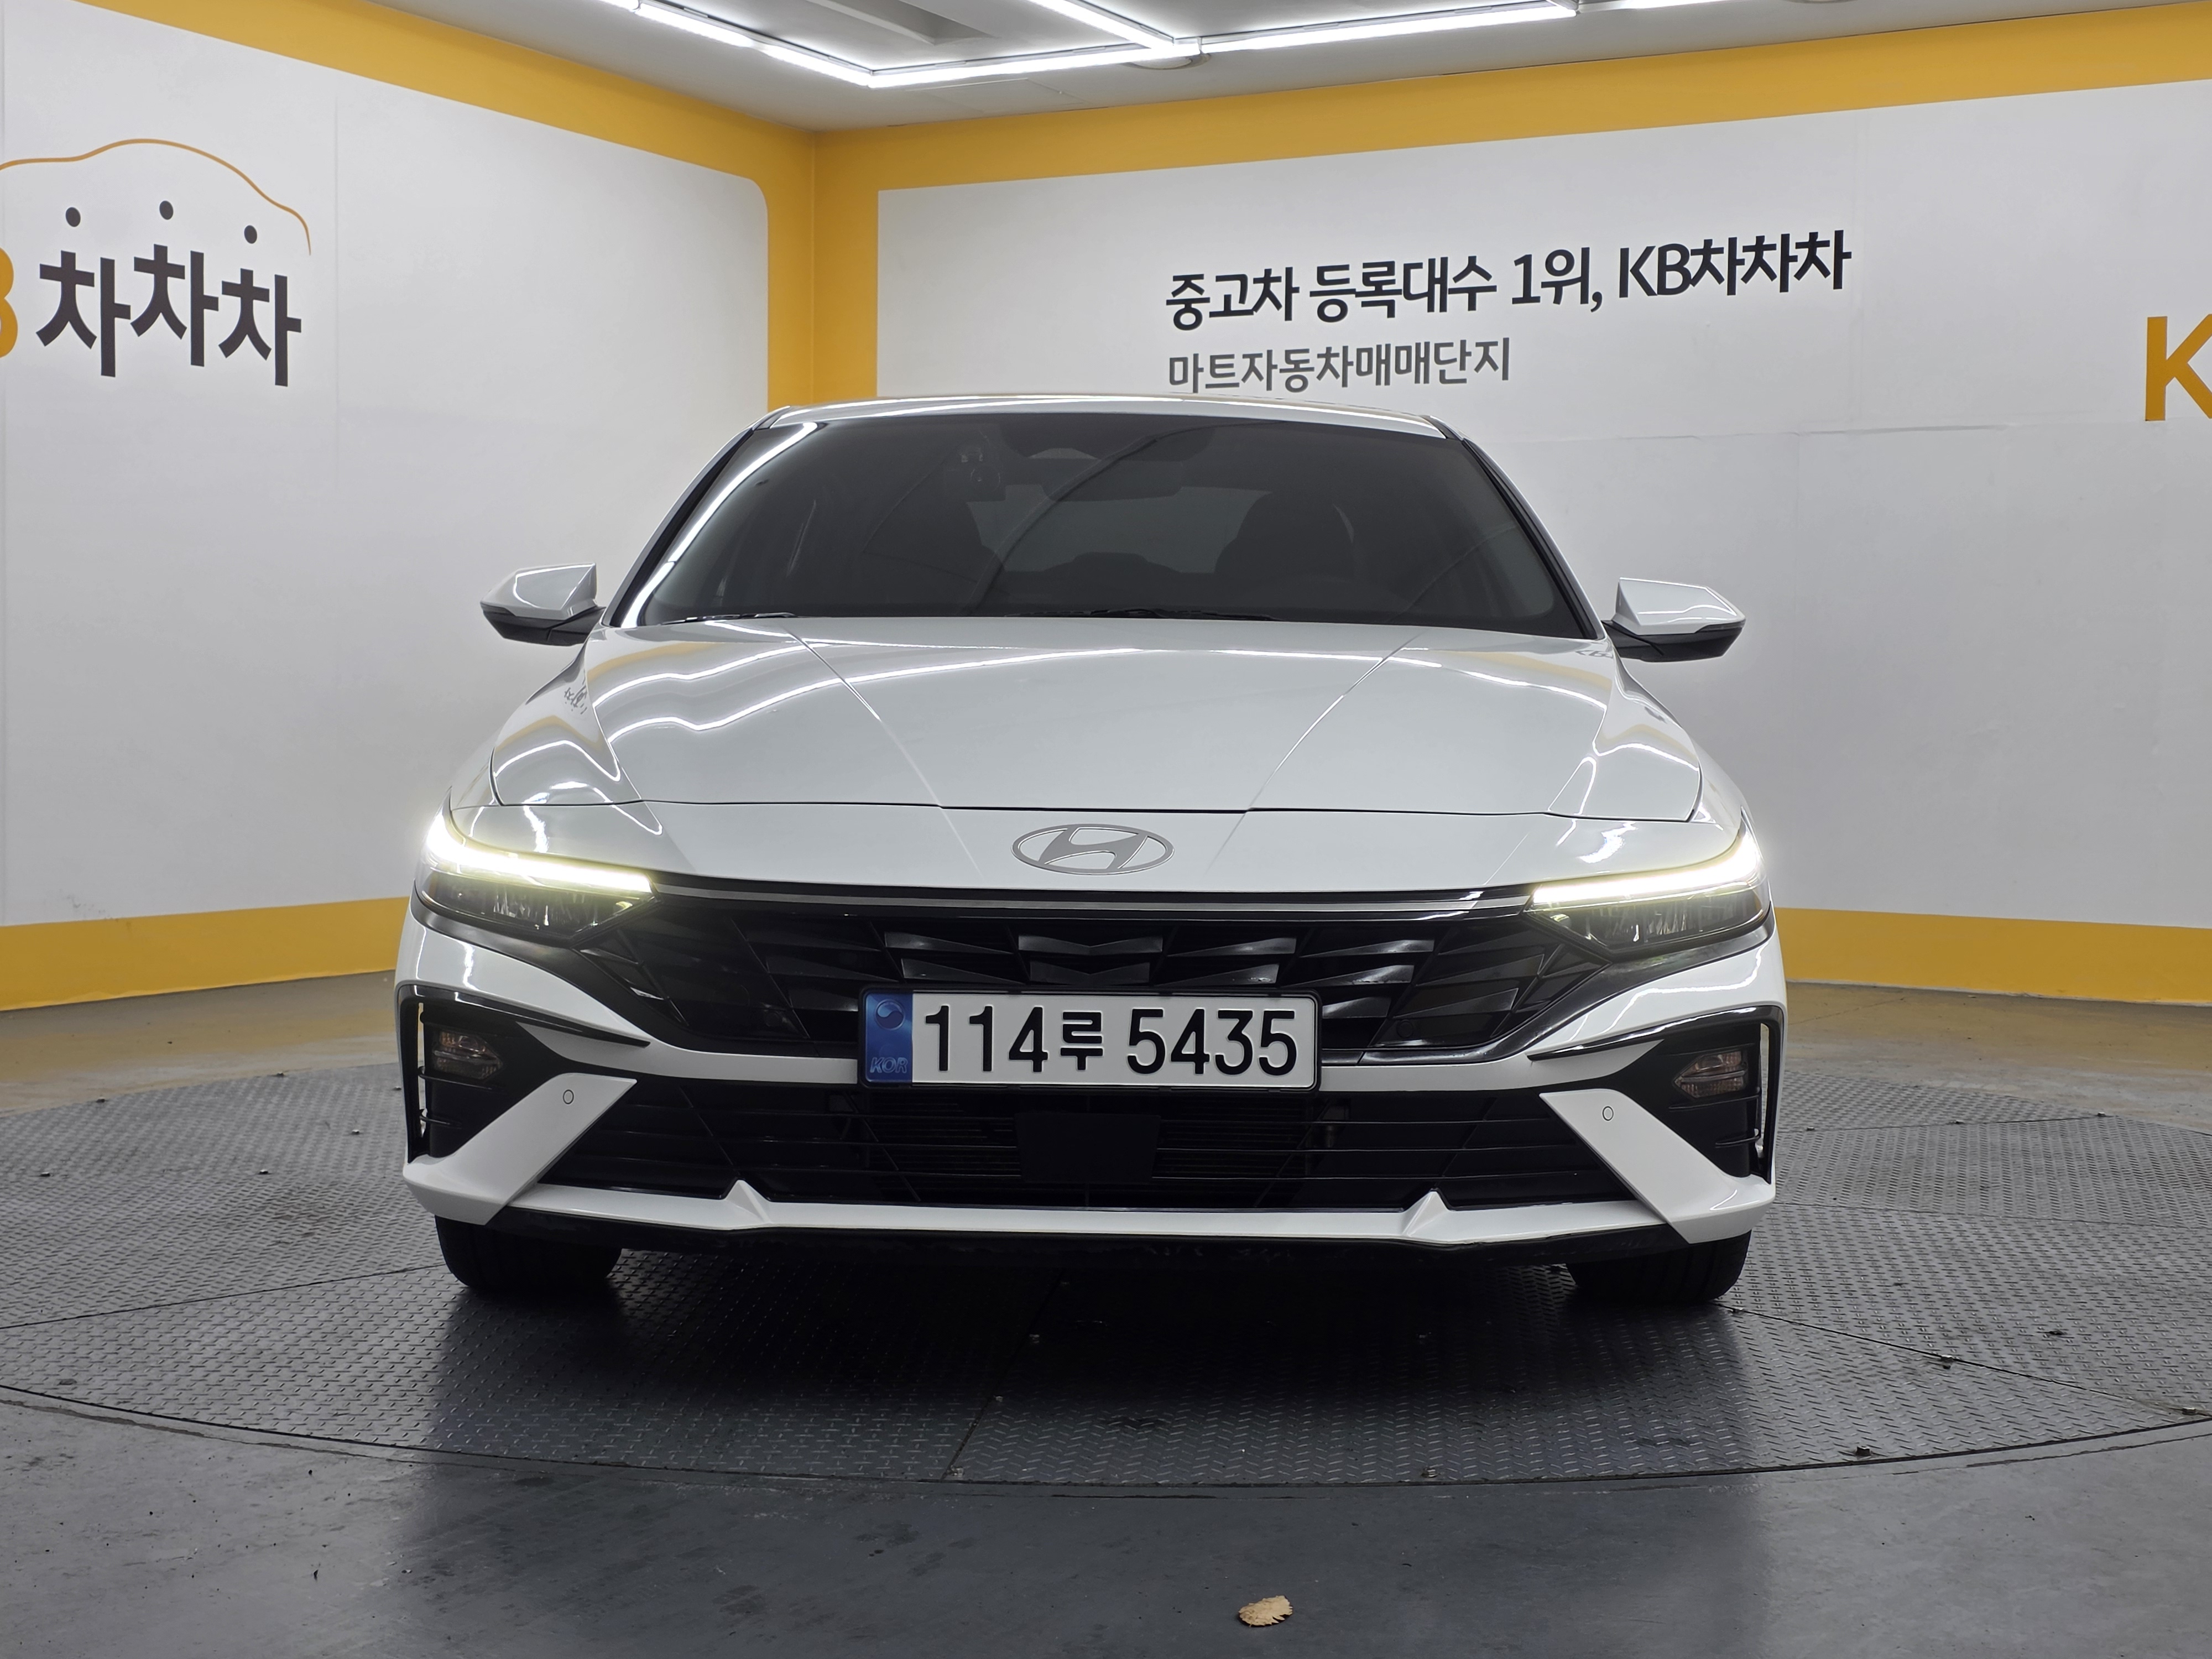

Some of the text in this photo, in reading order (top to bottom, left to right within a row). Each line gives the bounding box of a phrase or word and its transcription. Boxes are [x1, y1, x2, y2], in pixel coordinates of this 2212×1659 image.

[35, 243, 302, 387] 차차차
[1165, 229, 1853, 331] 중고차 등록대수 1위, KB차차차
[1168, 337, 1510, 393] 마트자동차매매단지
[869, 1056, 908, 1073] KOR
[925, 1005, 1297, 1076] 114루 5435
